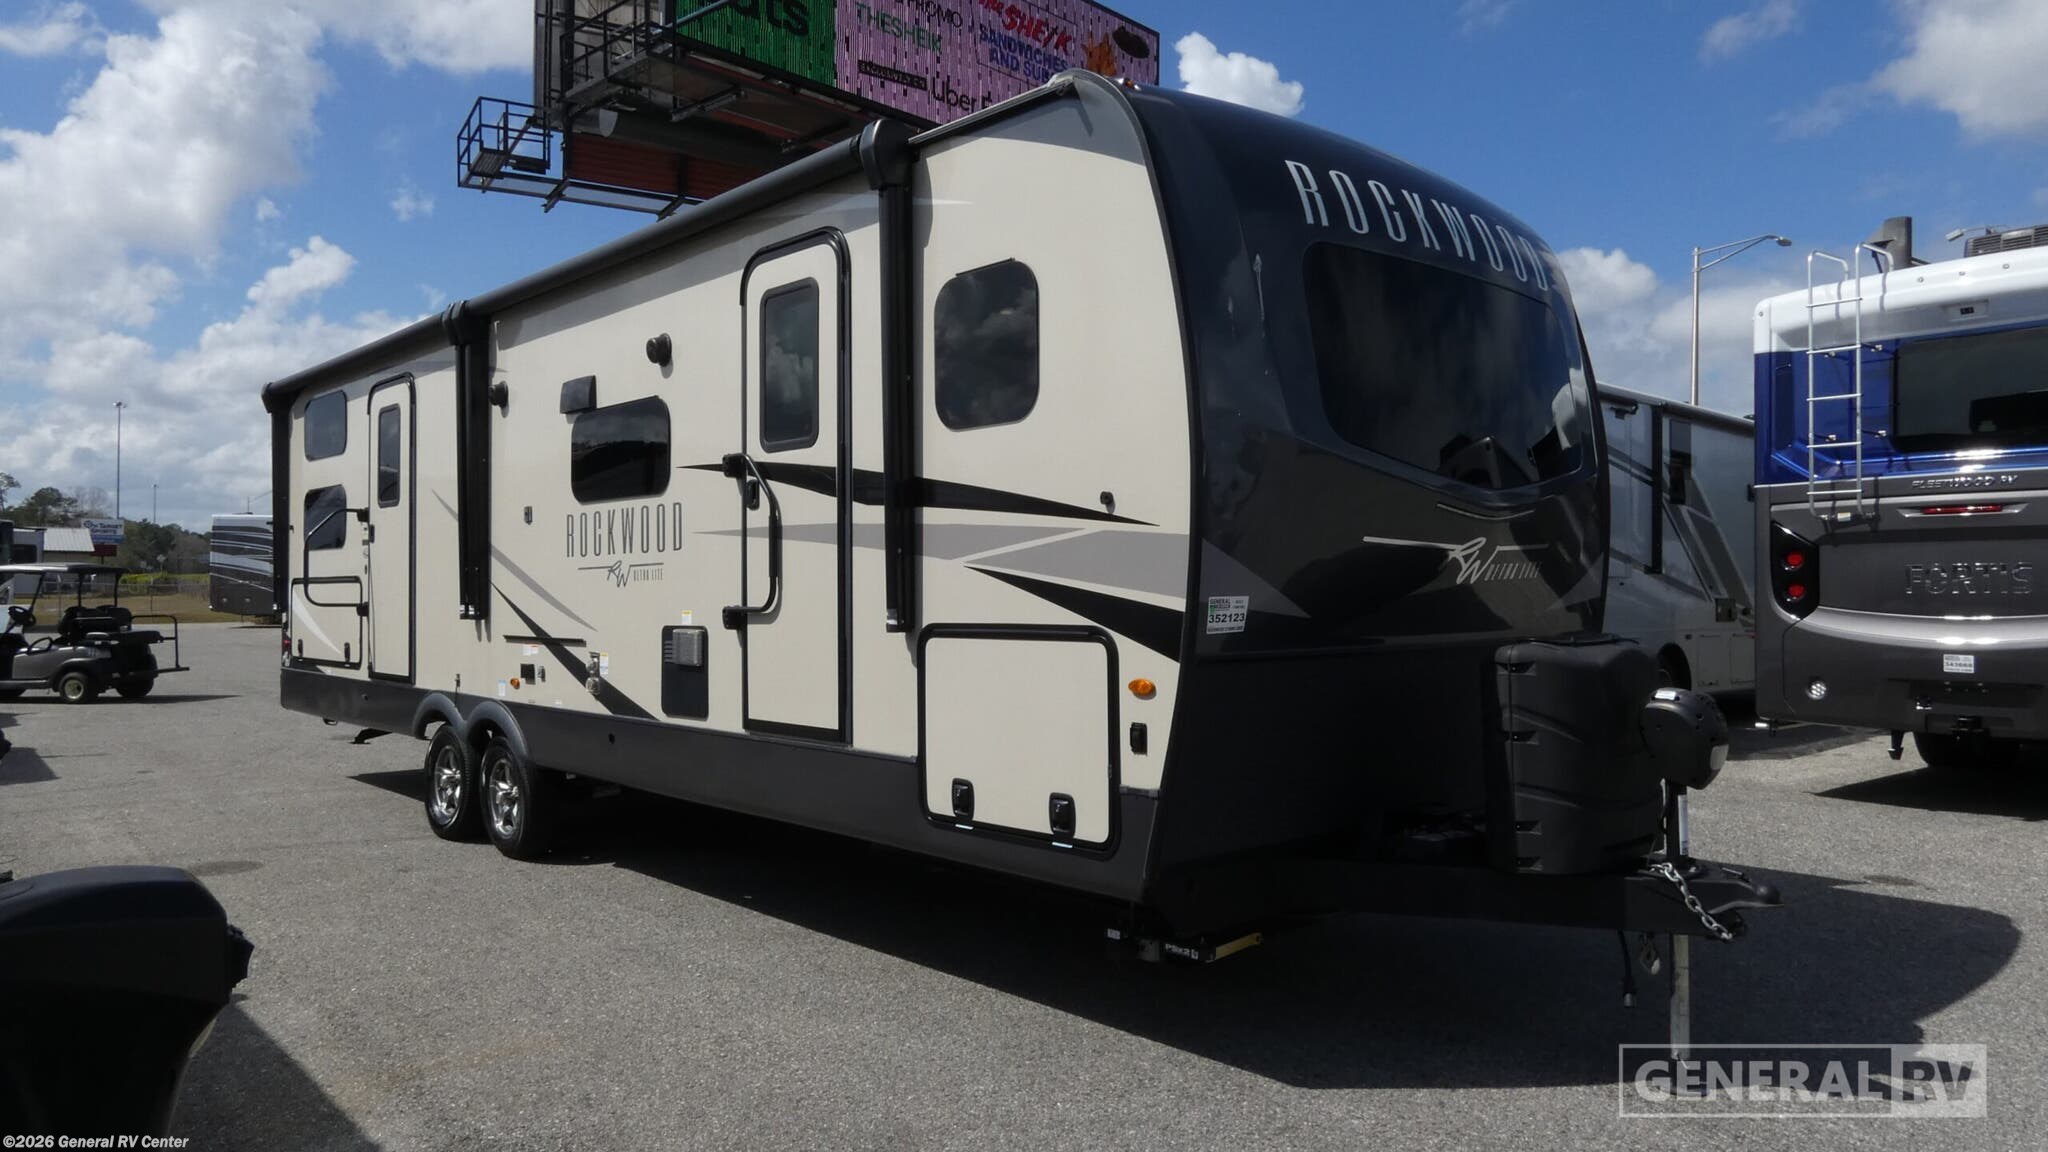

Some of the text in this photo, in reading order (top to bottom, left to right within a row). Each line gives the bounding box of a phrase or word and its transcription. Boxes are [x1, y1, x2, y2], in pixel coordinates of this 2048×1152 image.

[855, 2, 943, 54] THESHEIK
[979, 23, 1069, 72] SANDWICHES
[988, 48, 1056, 83] AND SUB
[932, 76, 977, 113] Uber
[1284, 160, 1549, 291] ROCKWOOD
[1912, 476, 1995, 489] FLEETWOOD
[567, 502, 682, 557] ROCKWOOD
[1905, 562, 2032, 594] FORTIS
[1208, 613, 1245, 624] 352123
